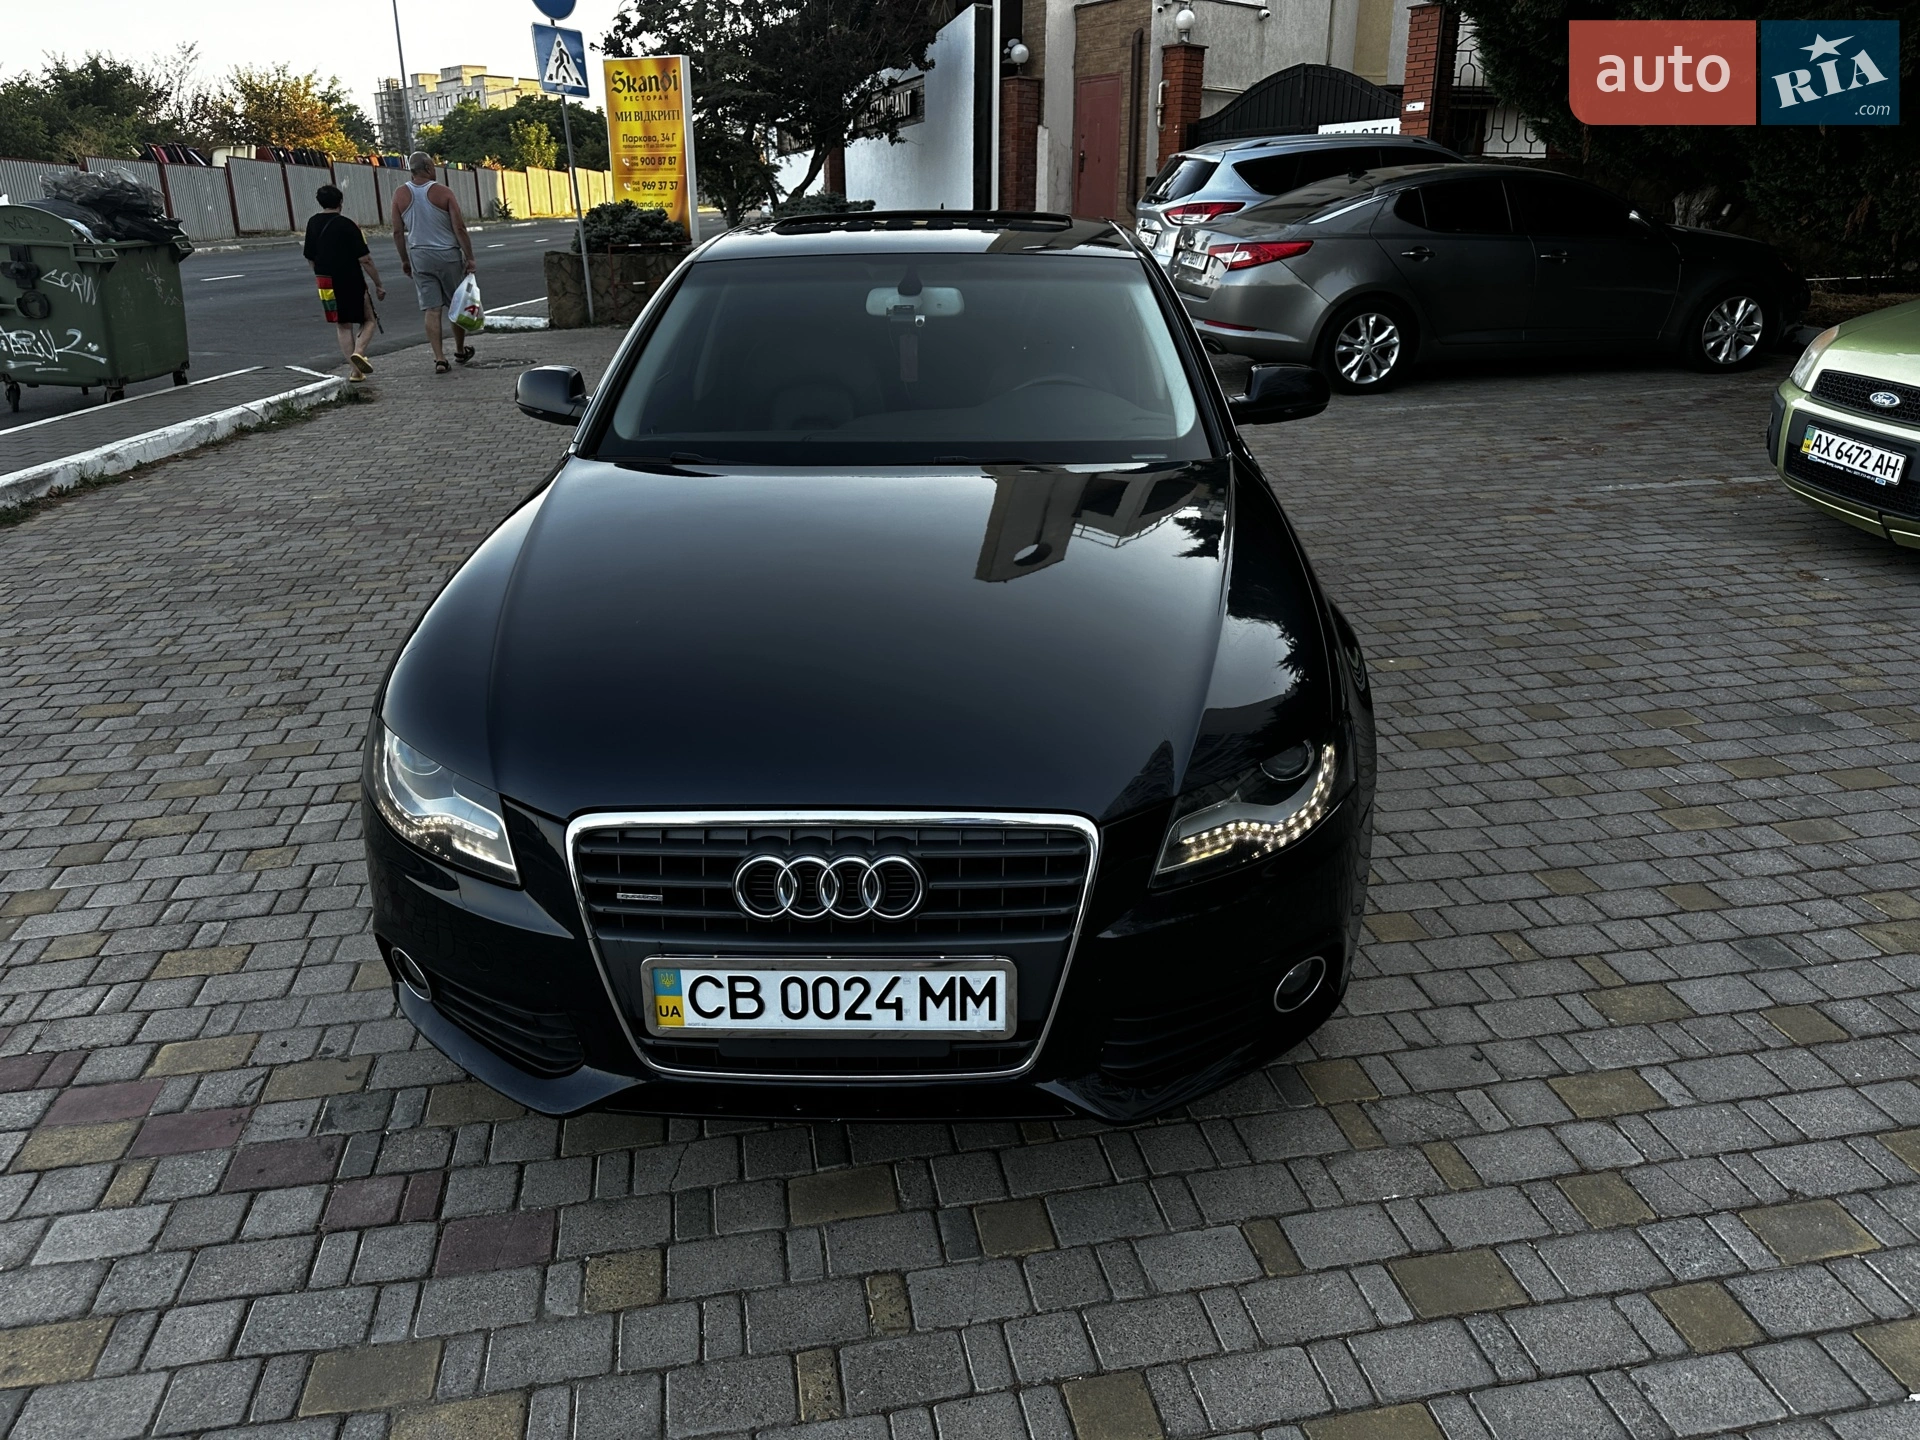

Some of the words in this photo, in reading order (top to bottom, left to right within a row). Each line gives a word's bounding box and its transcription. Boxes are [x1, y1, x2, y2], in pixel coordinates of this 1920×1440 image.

[611, 68, 679, 94] Skandi
[623, 94, 669, 102] РЕСТОРАН
[614, 111, 632, 122] МИ
[634, 110, 680, 123] ВІДКРИТІ
[622, 133, 660, 145] Паркова,
[660, 133, 670, 142] 34
[639, 156, 656, 166] 900
[657, 156, 667, 166] 87
[667, 156, 677, 166] 87
[641, 180, 657, 191] 969
[657, 180, 668, 191] 37
[669, 180, 679, 191] 37
[1811, 433, 1835, 457] AX
[1834, 441, 1872, 469] 6472
[1871, 453, 1900, 479] AH
[687, 975, 766, 1020] CB
[779, 975, 904, 1022] 0024
[918, 976, 997, 1022] MM
[659, 1005, 681, 1018] UA
